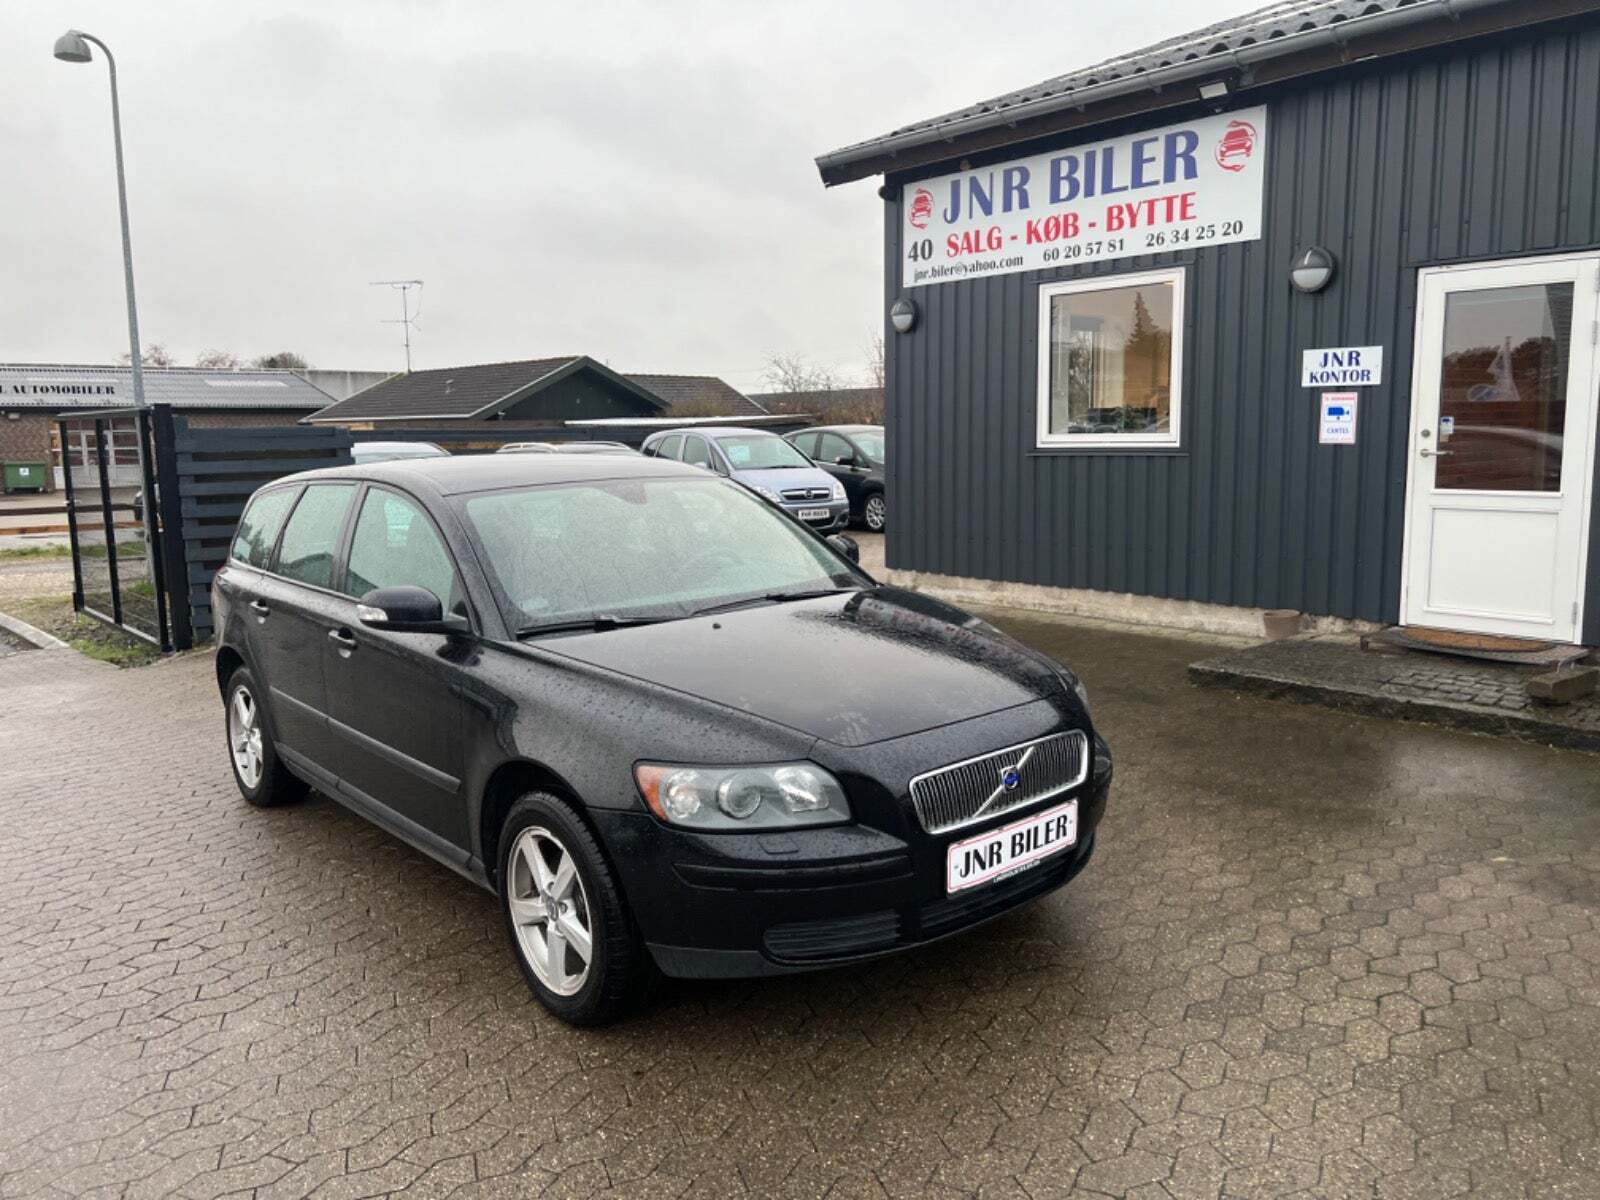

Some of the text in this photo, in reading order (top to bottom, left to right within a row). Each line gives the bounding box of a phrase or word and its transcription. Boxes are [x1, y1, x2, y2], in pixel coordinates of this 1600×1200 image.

[943, 129, 1200, 225] JNR BILER
[947, 225, 1002, 258] SALG
[1026, 211, 1079, 245] KØB
[1106, 191, 1196, 232] BYTTE
[908, 238, 933, 262] 40
[1043, 219, 1244, 262] 60 20 57 81 26 34 25 20
[914, 256, 1024, 282] jnr.biler@yahoo.com
[1318, 350, 1361, 368] JNR
[10, 384, 115, 395] AUTOMOBILER
[1309, 369, 1371, 384] KONTOR
[959, 840, 1003, 878] JNR
[1010, 814, 1068, 859] BILER
